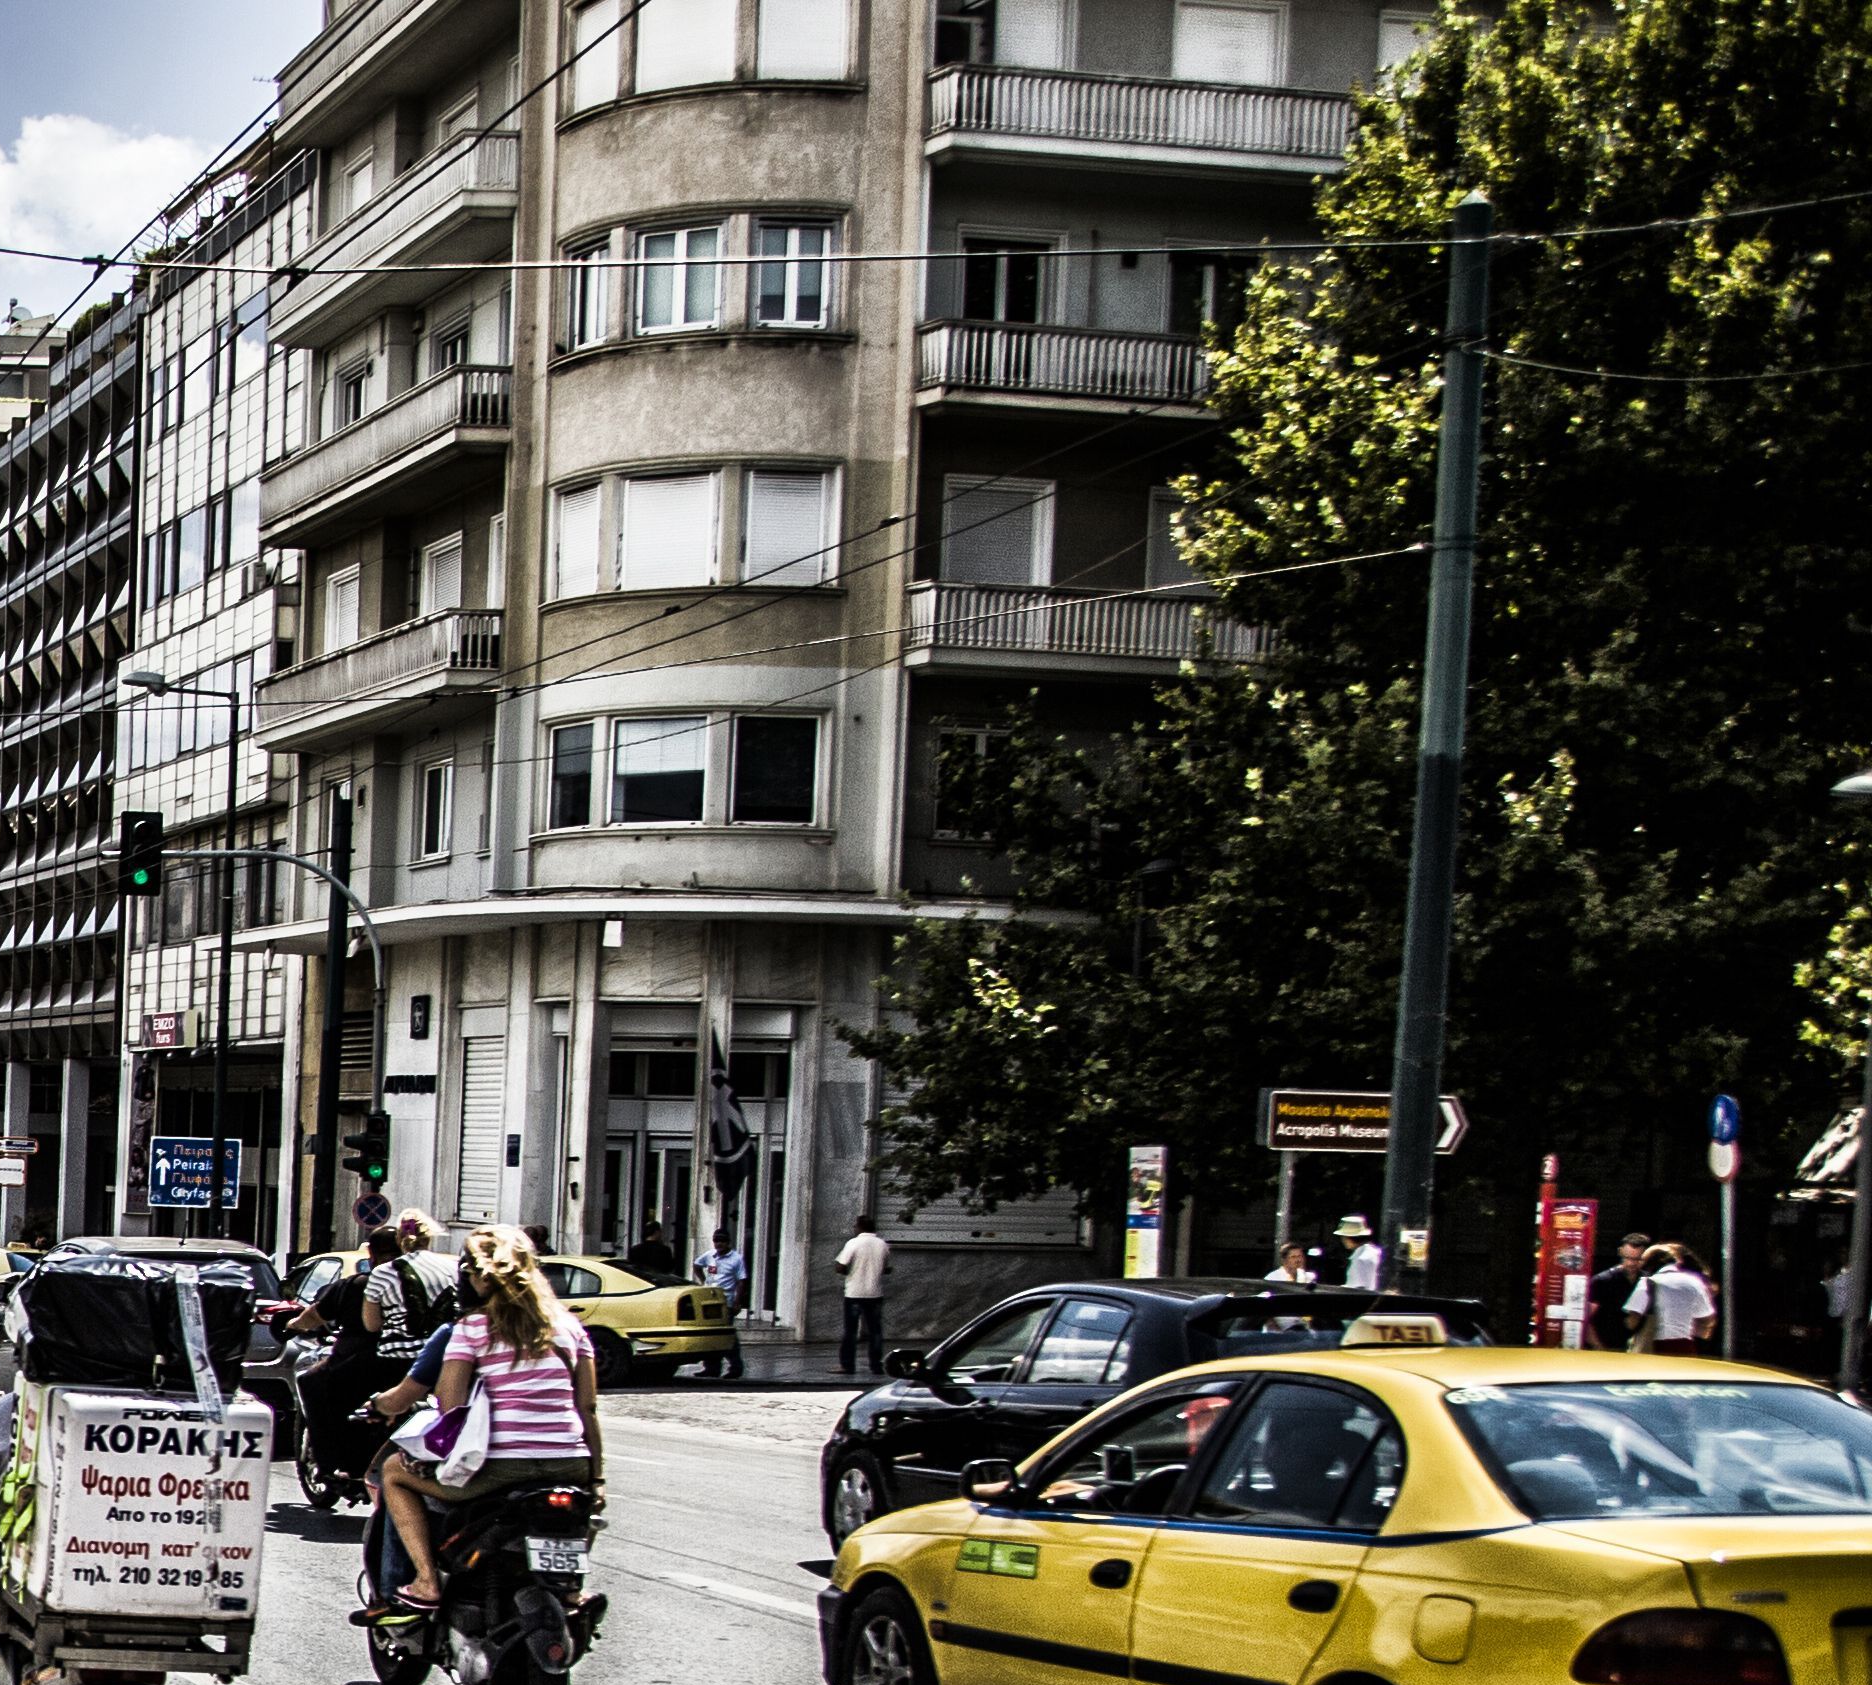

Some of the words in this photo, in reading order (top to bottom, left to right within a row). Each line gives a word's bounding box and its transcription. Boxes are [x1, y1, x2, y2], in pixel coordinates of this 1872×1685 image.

[1276, 1122, 1336, 1139] Acropolis
[81, 1465, 151, 1502] Ψαρια
[158, 1472, 251, 1506] Φρεκα
[106, 1506, 145, 1523] Απο
[150, 1510, 172, 1524] το
[66, 1536, 150, 1560] Διανομη
[538, 1551, 580, 1570] 565
[119, 1566, 151, 1585] 210
